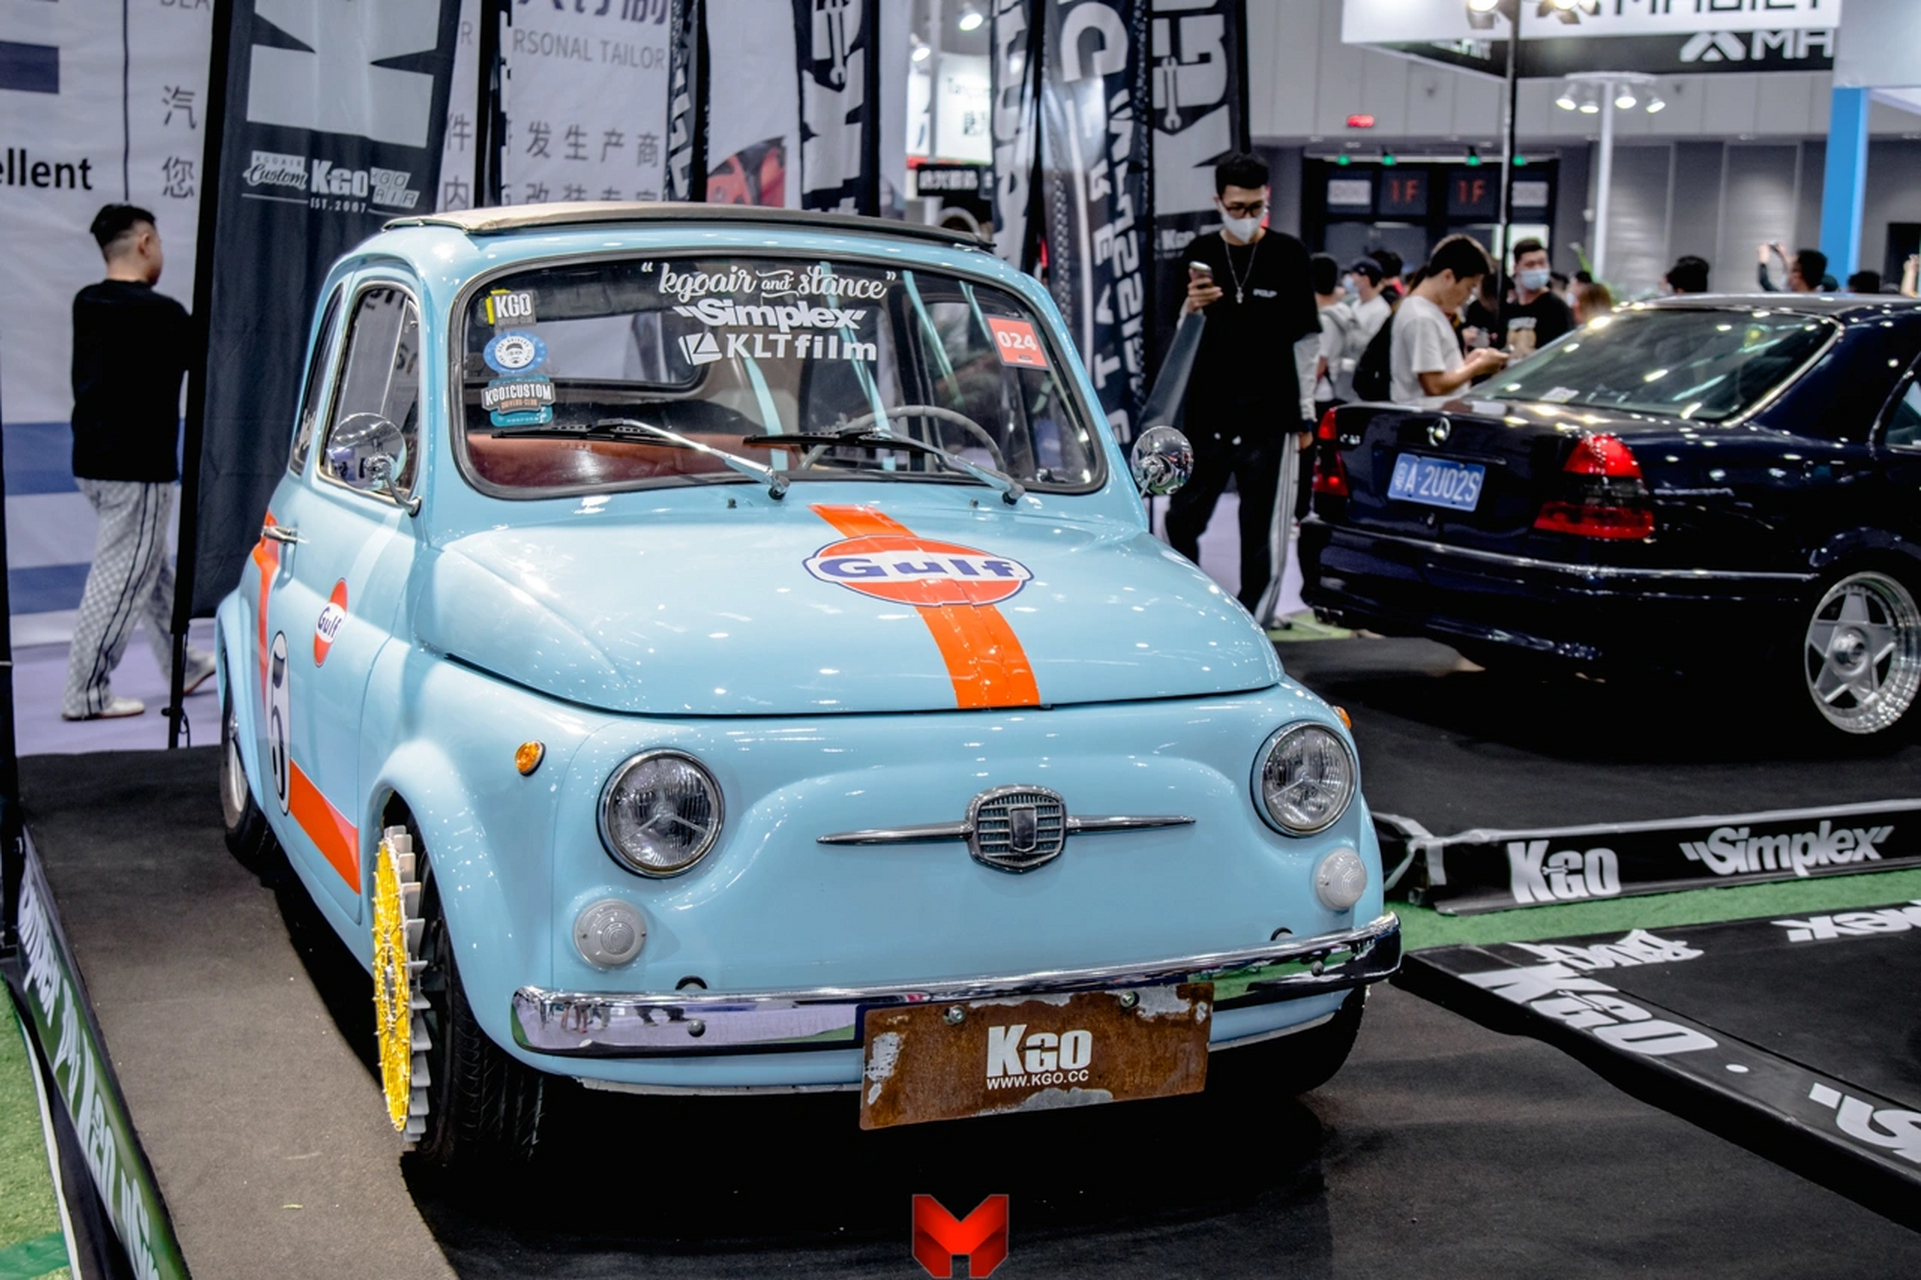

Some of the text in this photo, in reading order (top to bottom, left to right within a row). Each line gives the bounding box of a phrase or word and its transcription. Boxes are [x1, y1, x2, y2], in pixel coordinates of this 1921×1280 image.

[599, 40, 667, 70] TAILOR
[162, 86, 197, 130] 汽
[0, 147, 93, 191] llent
[161, 156, 195, 199] 您
[250, 163, 308, 190] Custom
[495, 293, 532, 318] KGO
[997, 330, 1037, 351] 024
[817, 557, 1015, 579] Gulf
[317, 606, 343, 639] Gulf
[1507, 839, 1622, 904] KGO
[986, 1023, 1093, 1079] KGO
[986, 1068, 1090, 1091] WWW.KGO.CC
